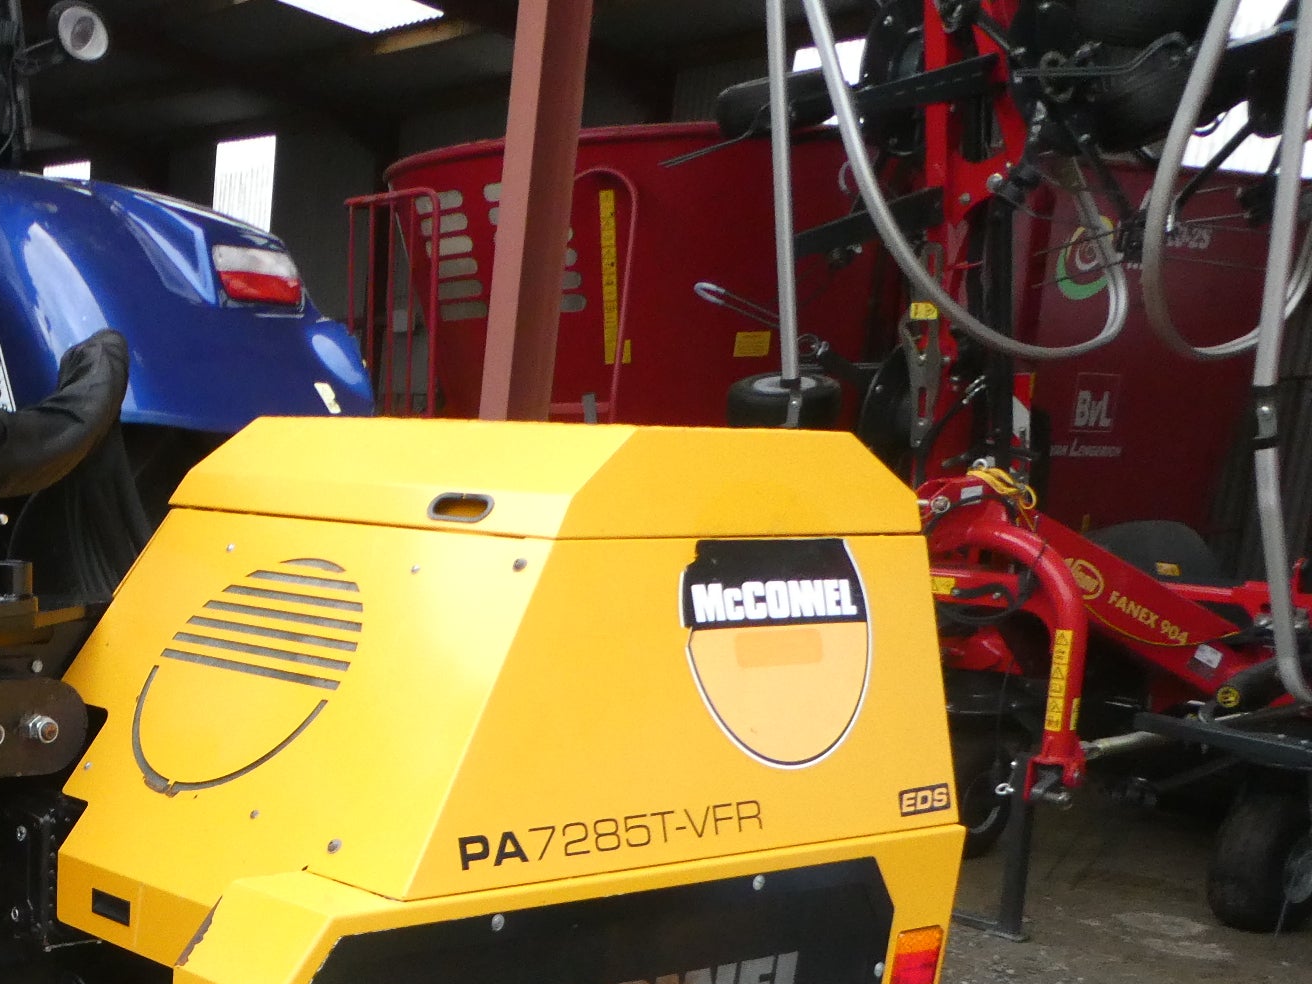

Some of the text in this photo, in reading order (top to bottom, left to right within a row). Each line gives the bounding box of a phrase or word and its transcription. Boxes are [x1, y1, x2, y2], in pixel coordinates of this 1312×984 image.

[691, 579, 857, 623] McCONNEL
[1108, 591, 1188, 646] FANEX 904
[901, 787, 949, 813] EDS
[458, 799, 763, 871] PA7285T-VFR
